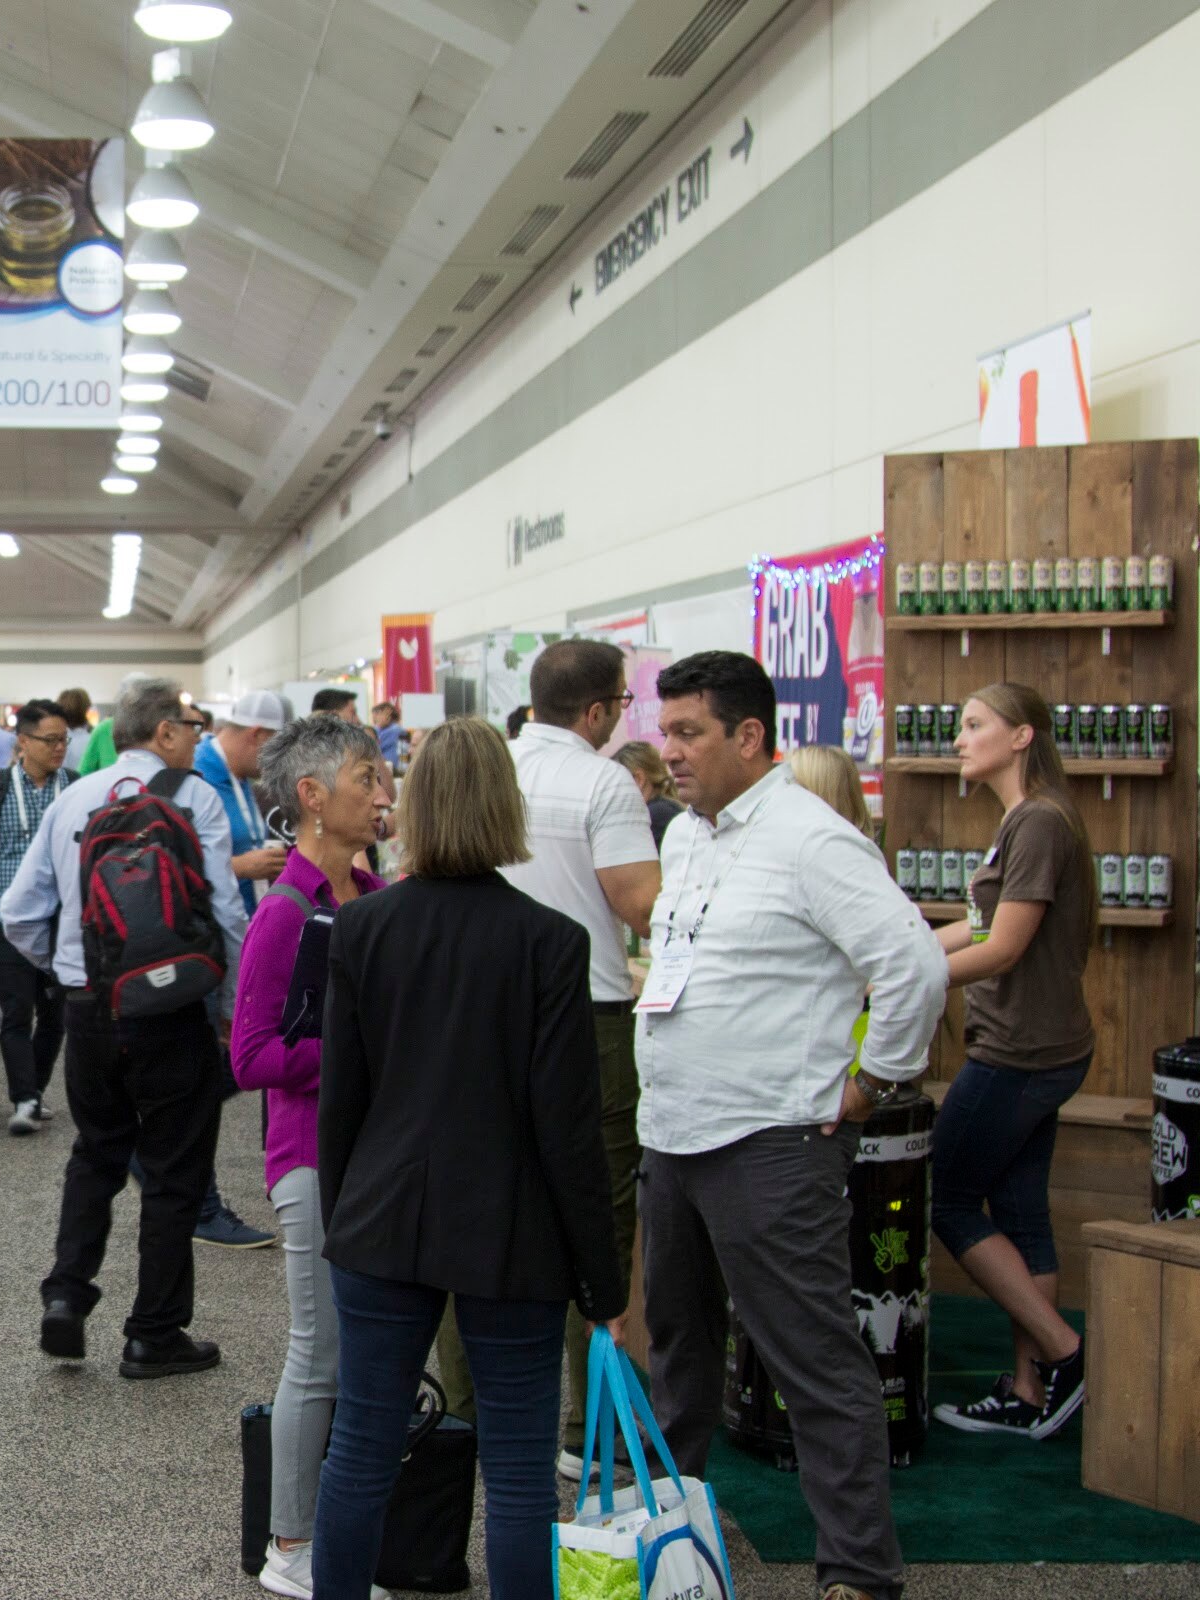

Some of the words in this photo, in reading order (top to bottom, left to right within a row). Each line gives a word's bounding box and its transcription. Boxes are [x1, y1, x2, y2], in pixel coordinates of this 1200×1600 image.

[595, 186, 670, 296] EMERGENCY
[677, 146, 712, 223] EXIT
[38, 350, 49, 363] &
[50, 349, 112, 366] Specialty
[761, 567, 829, 679] GRAB
[806, 703, 819, 743] BY
[905, 1136, 926, 1152] COLD
